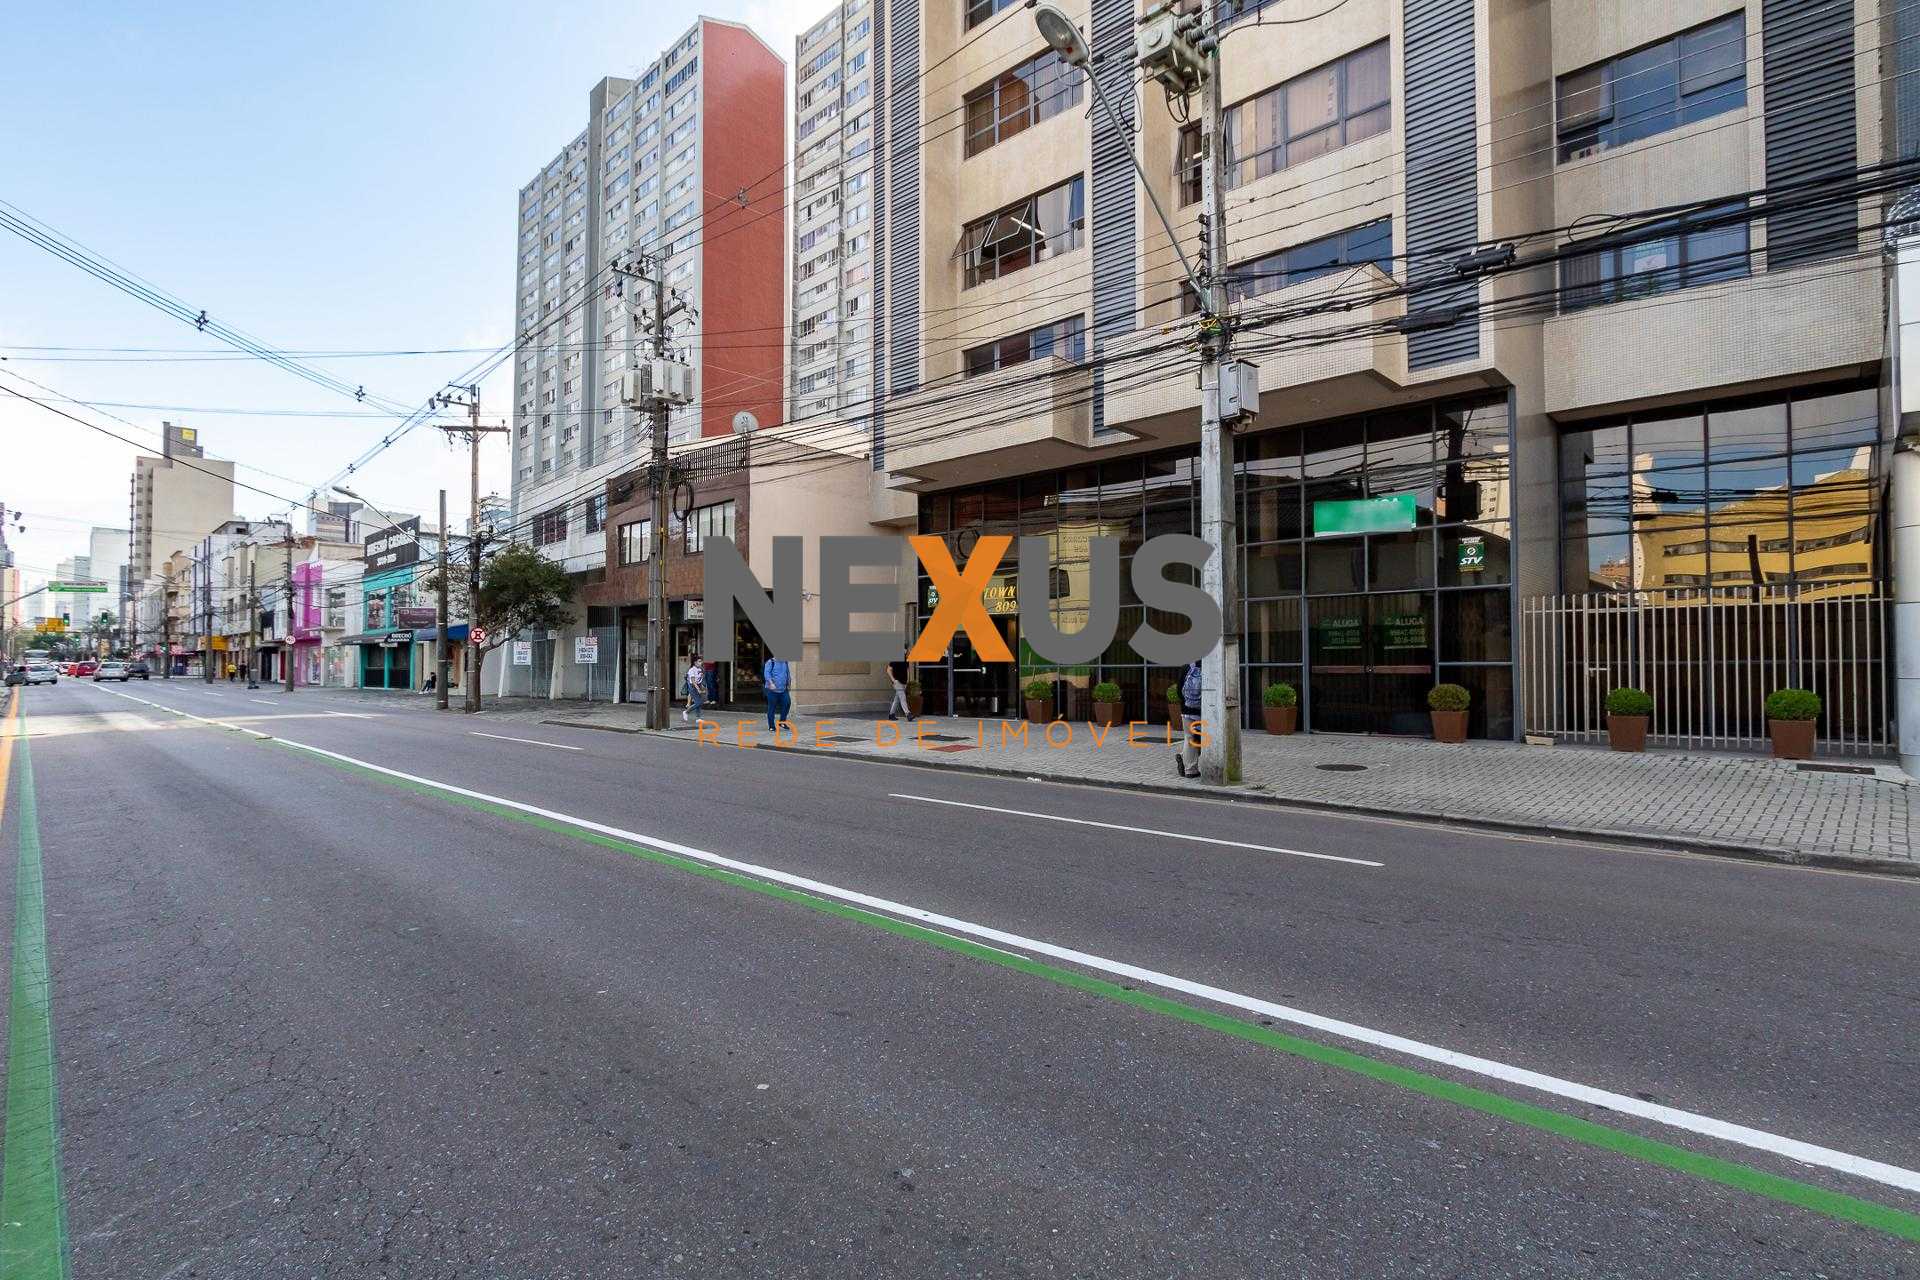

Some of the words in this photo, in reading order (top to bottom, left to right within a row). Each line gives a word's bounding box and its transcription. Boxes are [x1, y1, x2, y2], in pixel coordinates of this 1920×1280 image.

[1460, 556, 1483, 565] STV
[996, 600, 1017, 613] 809
[1395, 617, 1425, 625] ALUGA
